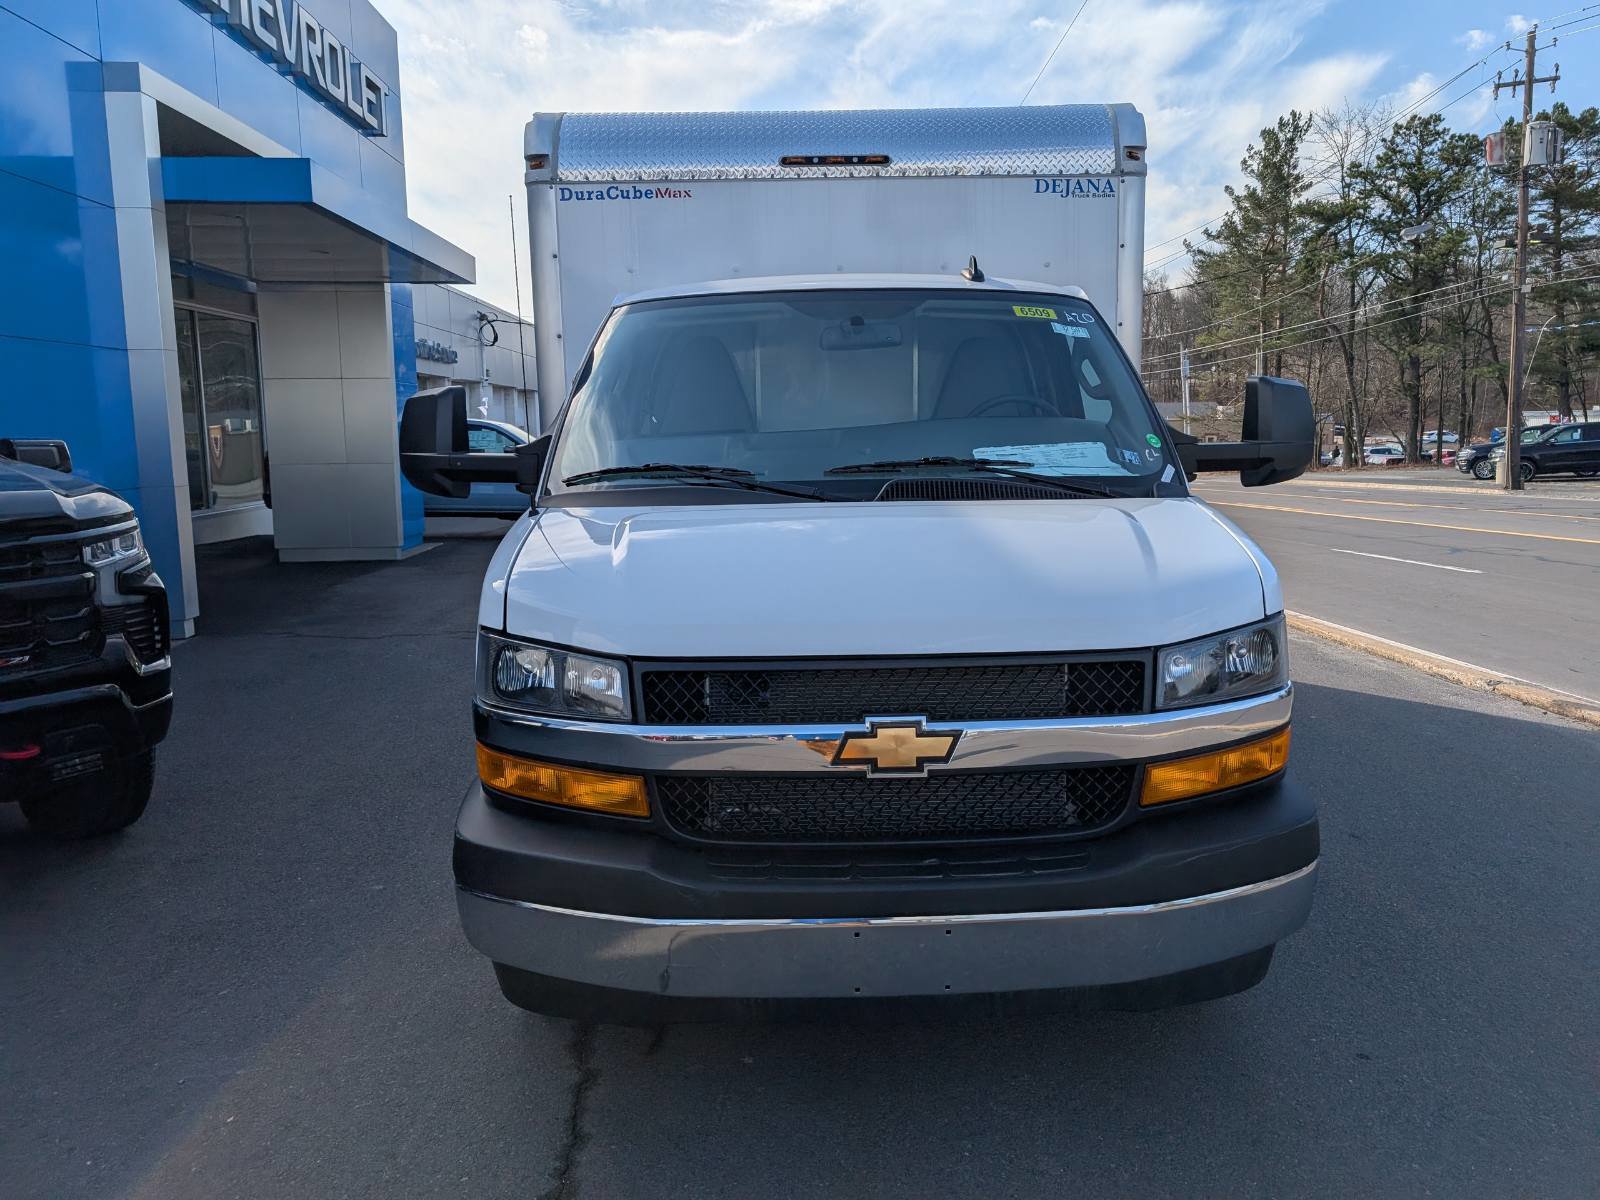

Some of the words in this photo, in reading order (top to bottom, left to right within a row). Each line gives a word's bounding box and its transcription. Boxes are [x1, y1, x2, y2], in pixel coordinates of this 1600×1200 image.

[210, 0, 389, 137] EVROLET
[559, 186, 692, 201] DuraCubeMax
[1034, 178, 1116, 198] DEJANA
[1020, 306, 1050, 317] 6509
